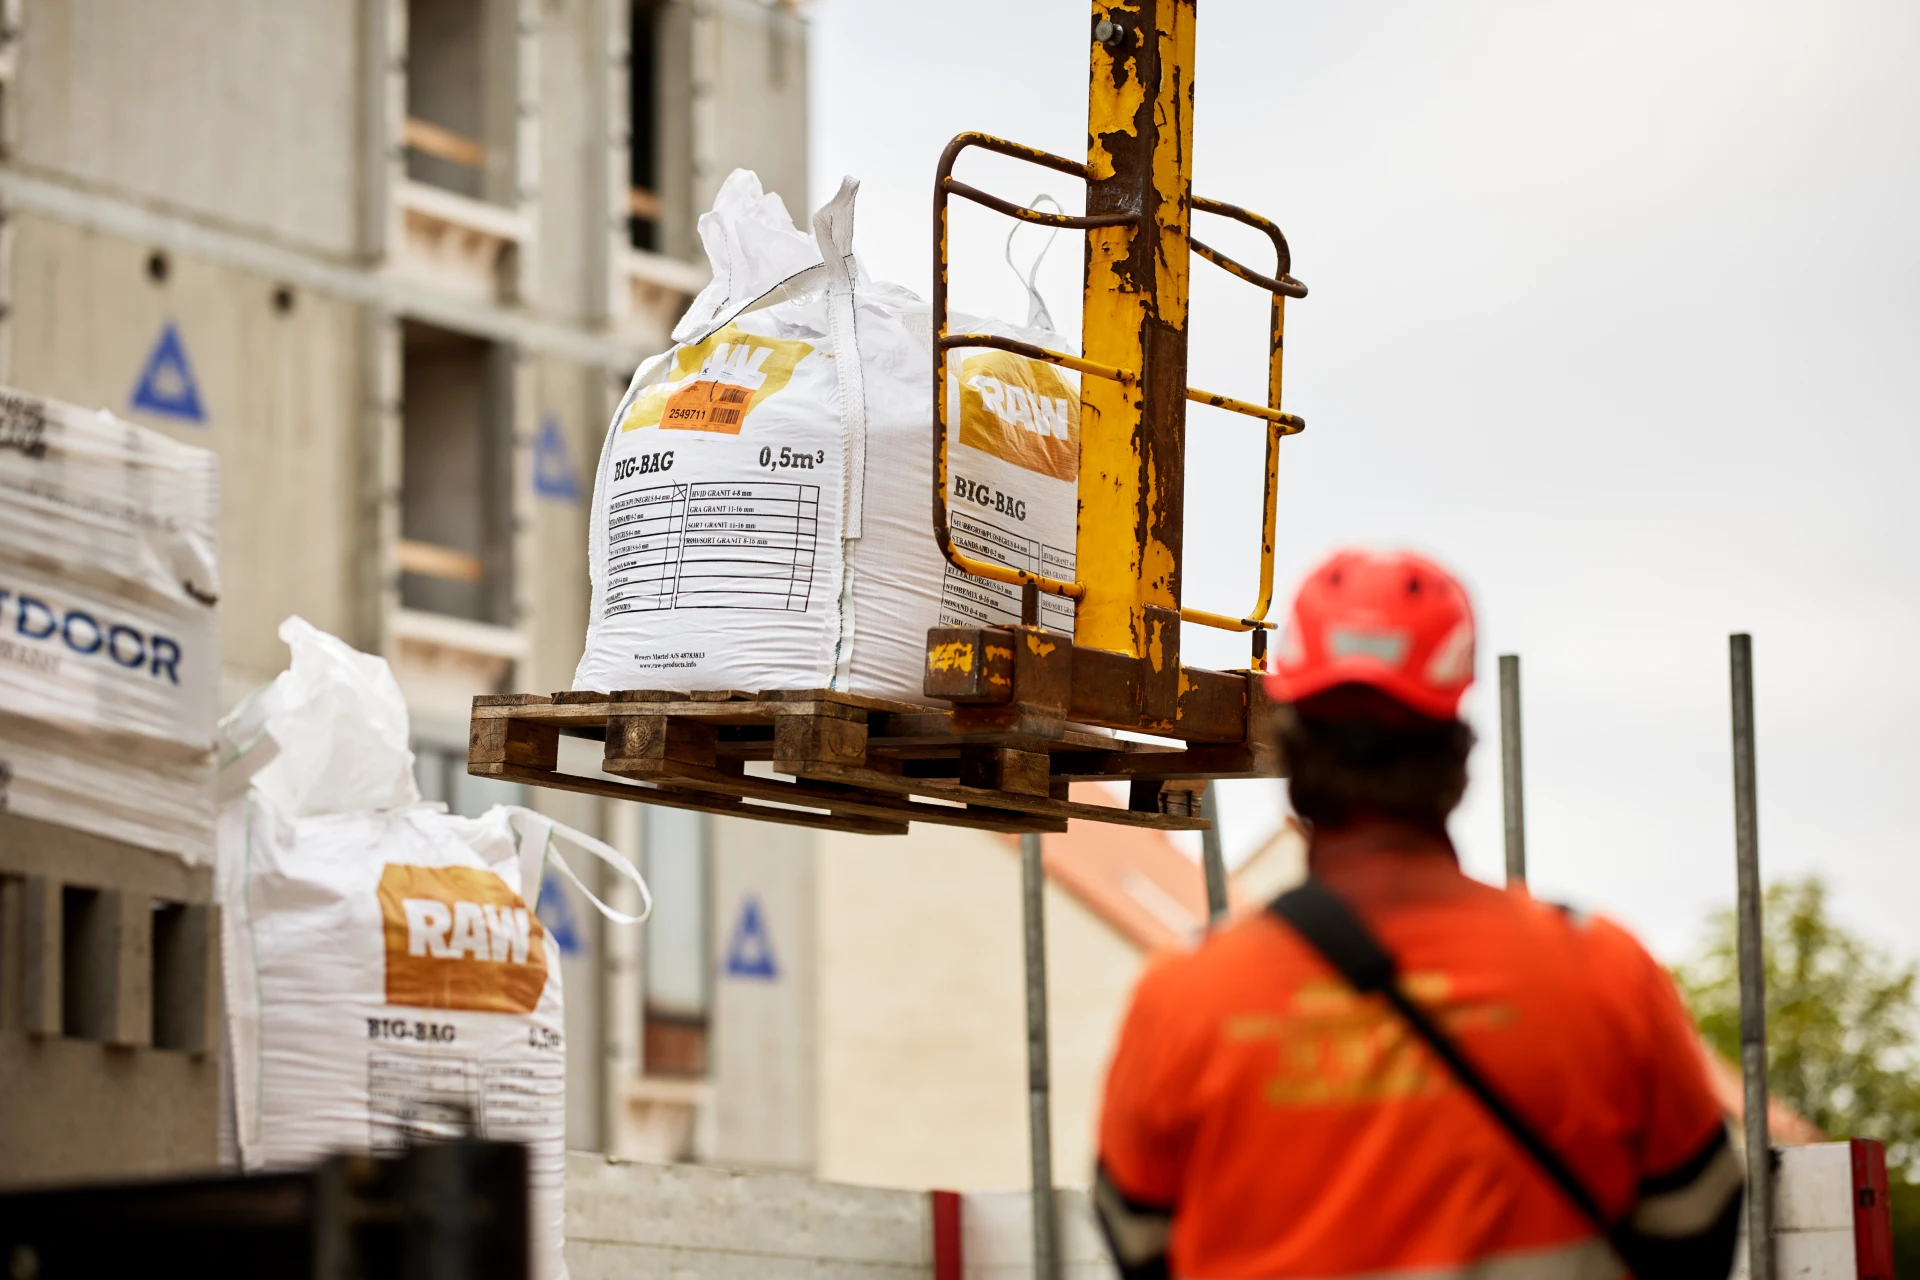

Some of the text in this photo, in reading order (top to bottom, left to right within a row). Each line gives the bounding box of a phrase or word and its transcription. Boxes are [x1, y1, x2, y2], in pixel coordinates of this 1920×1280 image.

[669, 408, 706, 420] 2549711
[967, 374, 1068, 441] RAW
[614, 446, 824, 481] BIG-BAG 0,5m³
[692, 490, 706, 498] HVID
[954, 475, 1026, 522] BIG-BAG
[952, 535, 990, 553] STRANDSAND
[1054, 556, 1069, 566] GRANIT
[946, 584, 978, 600] STØBEMIX
[978, 594, 990, 604] 0-16
[1004, 588, 1012, 596] mm
[943, 598, 988, 620] SØSAND 0-4 mm
[942, 614, 975, 627] STABIL
[640, 661, 697, 670] www.raw-products.info
[402, 898, 530, 965] RAW
[367, 1018, 456, 1043] BIG-BAG
